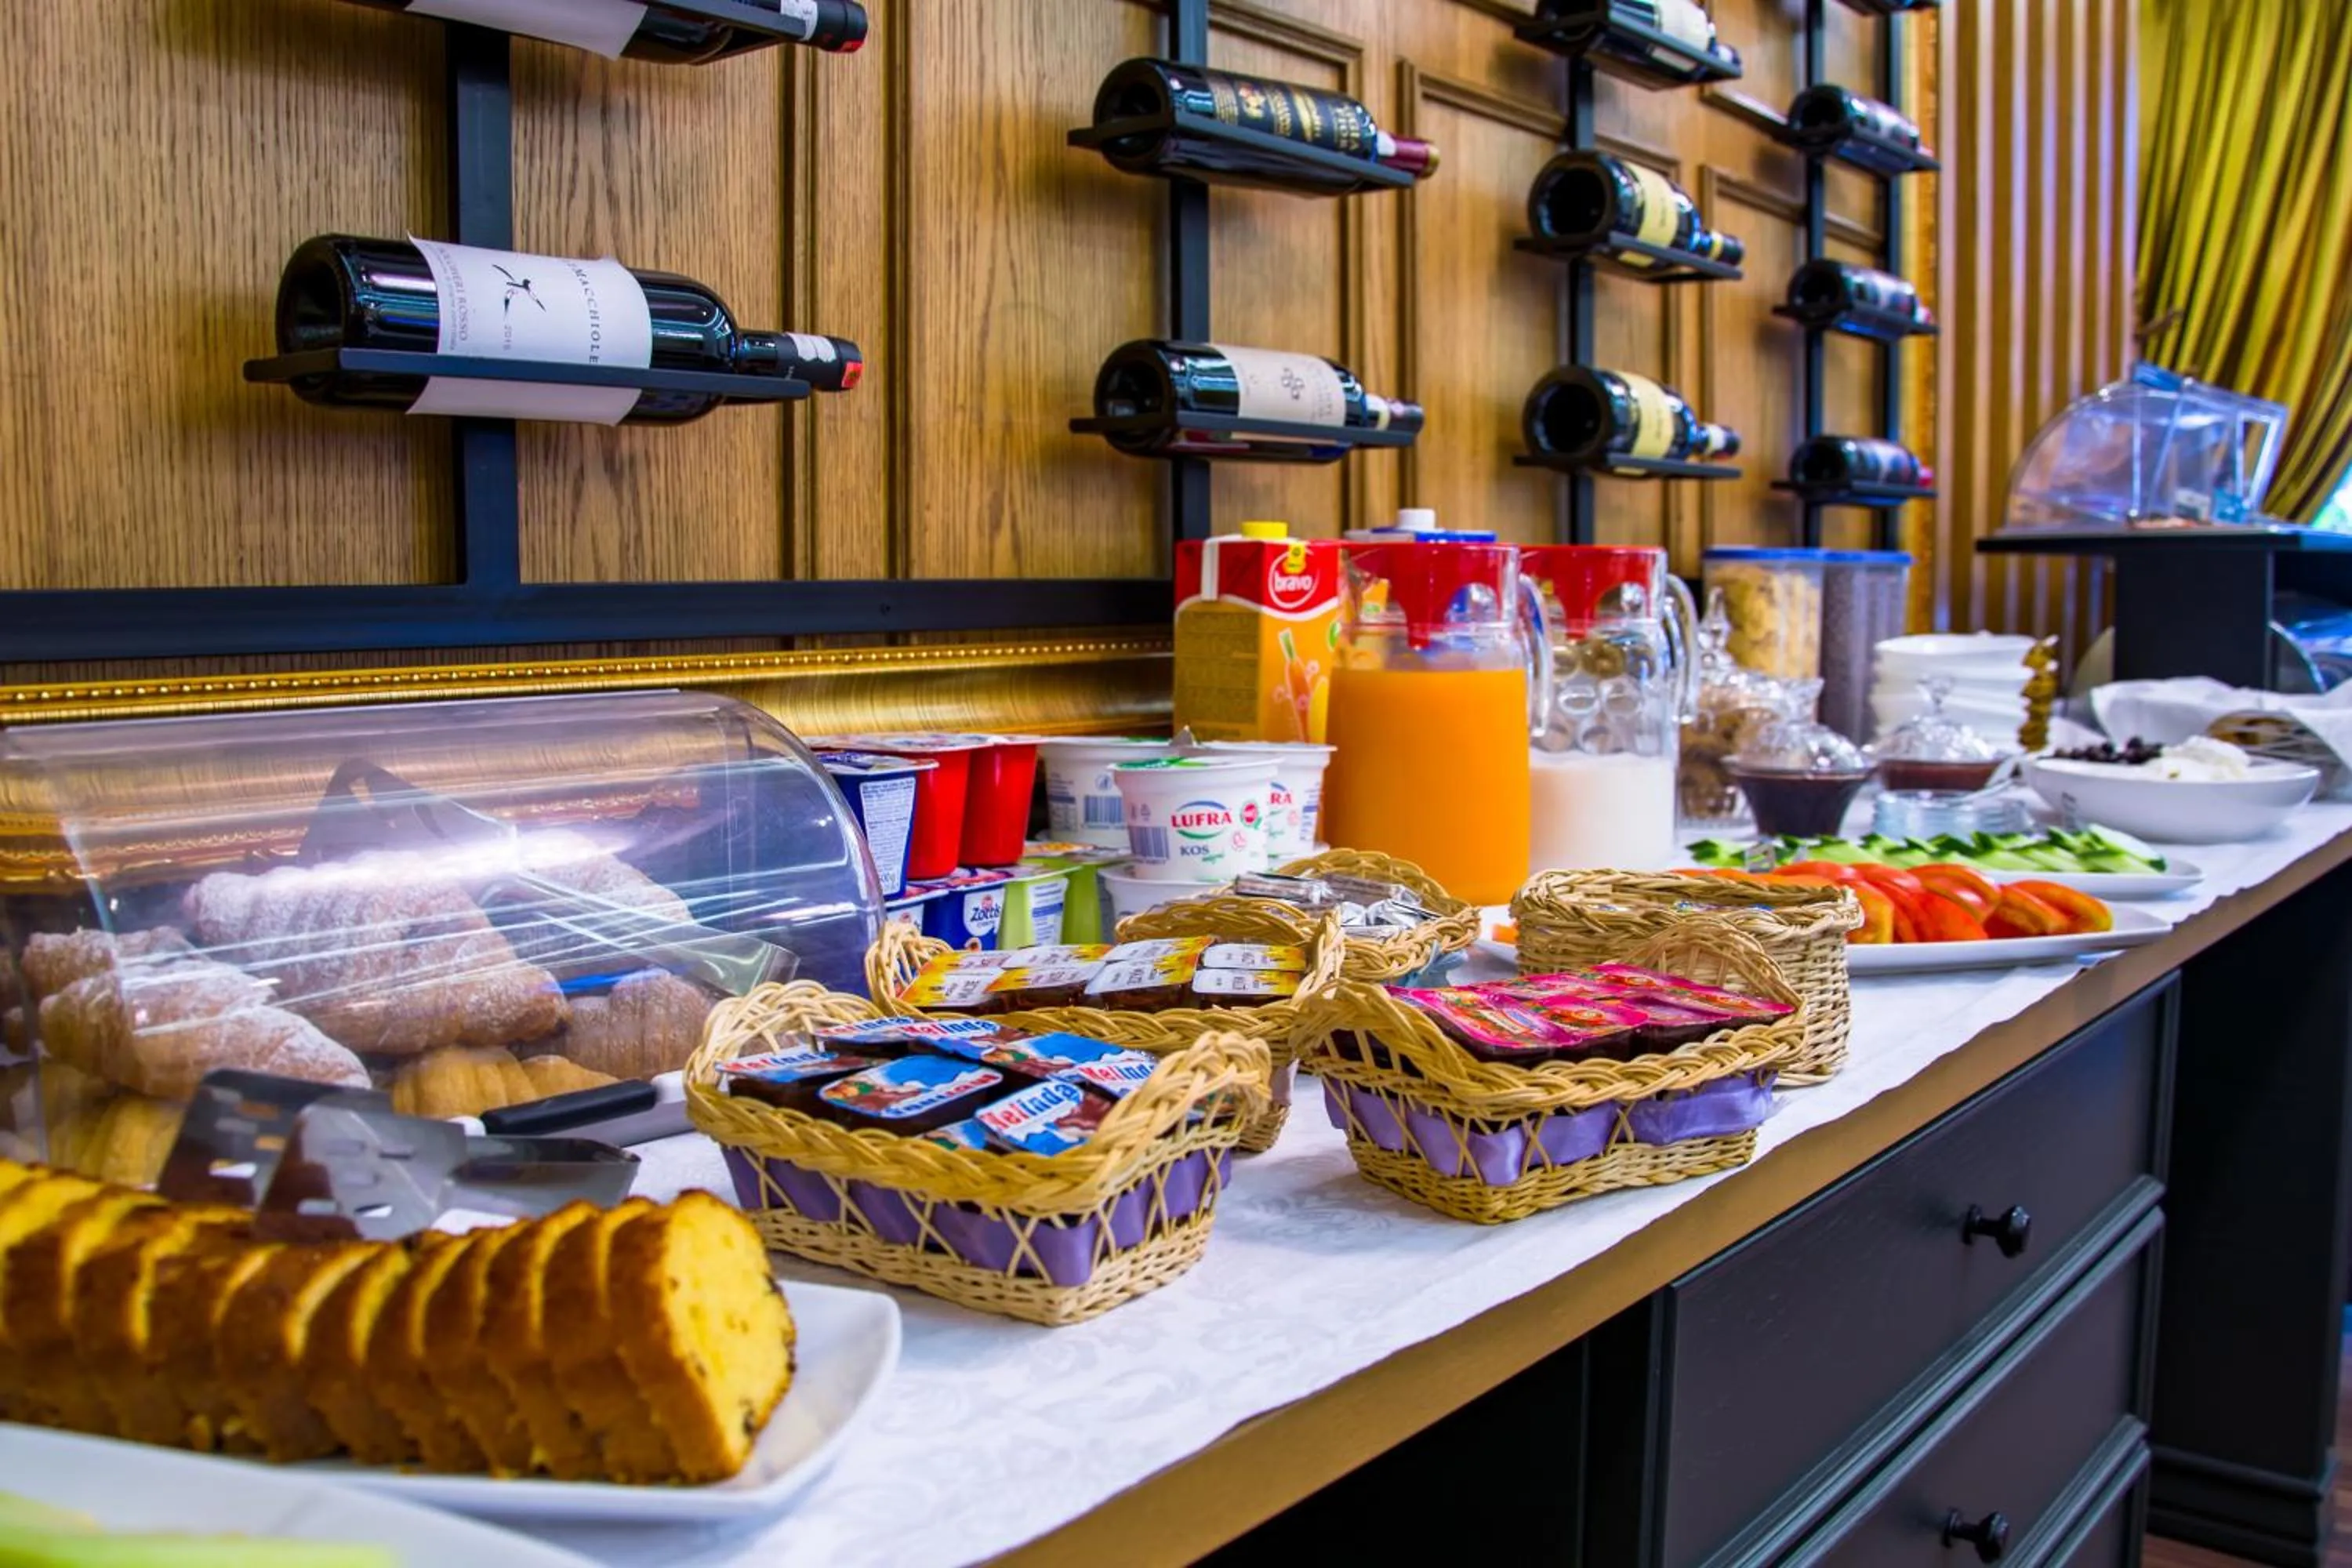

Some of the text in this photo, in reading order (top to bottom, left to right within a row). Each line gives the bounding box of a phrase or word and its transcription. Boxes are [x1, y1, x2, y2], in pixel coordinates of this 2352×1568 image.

[458, 297, 468, 342] ROSSO
[1274, 572, 1312, 591] bravo
[1171, 812, 1232, 829] LUFRA
[1179, 844, 1210, 856] KOS
[1079, 1062, 1156, 1083] Melind
